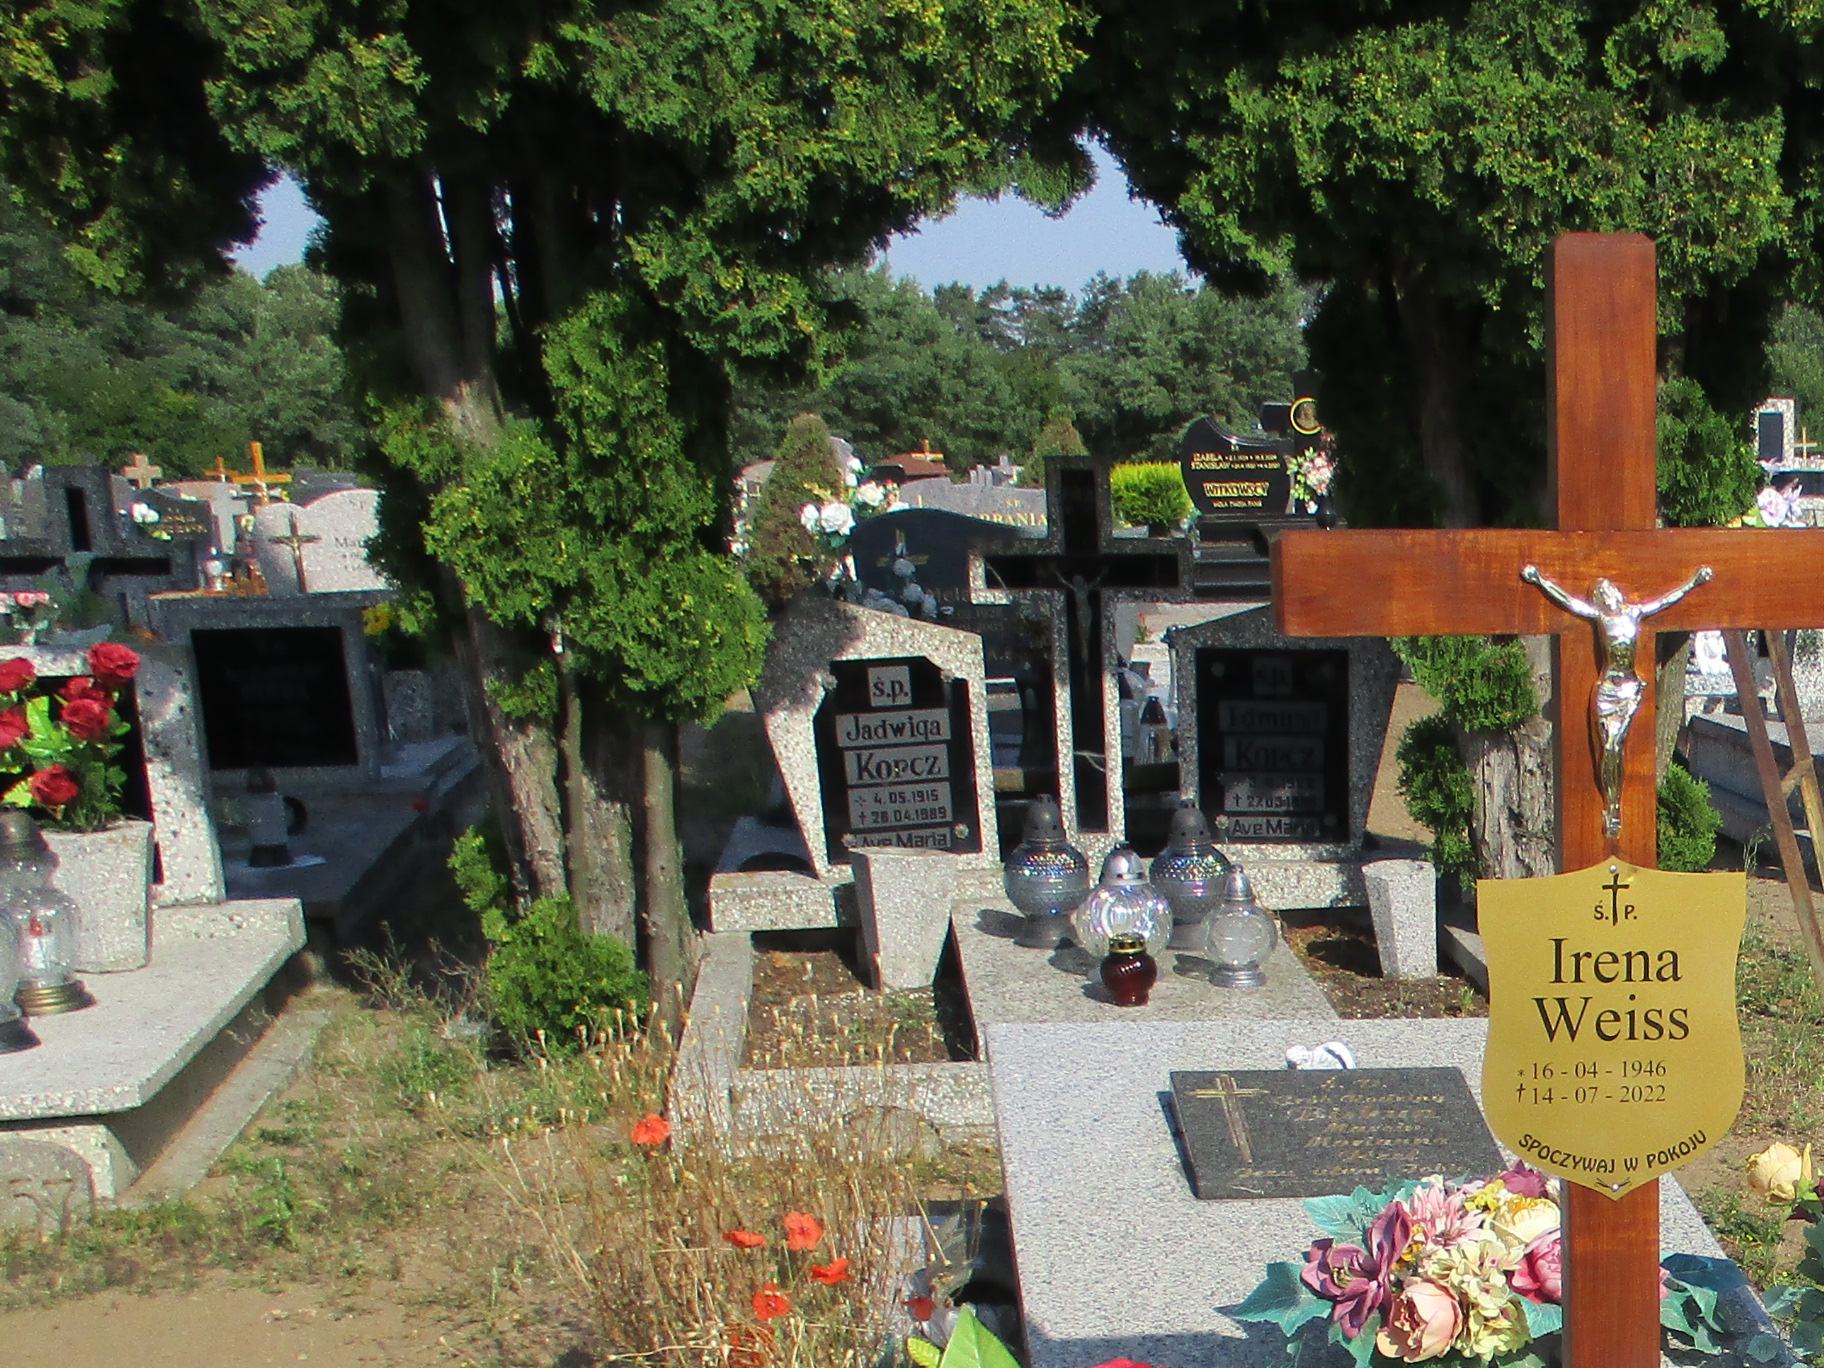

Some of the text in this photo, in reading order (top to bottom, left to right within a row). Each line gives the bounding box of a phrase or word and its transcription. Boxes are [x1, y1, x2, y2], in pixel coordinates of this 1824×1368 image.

[845, 714, 943, 742] Jadwiga
[855, 751, 943, 781] Kopcz
[1232, 818, 1263, 836] Ave
[1547, 936, 1683, 985] Irena
[1530, 993, 1690, 1043] Weiss
[1517, 1128, 1708, 1175] SPOCZYWAJ W POKOJU
